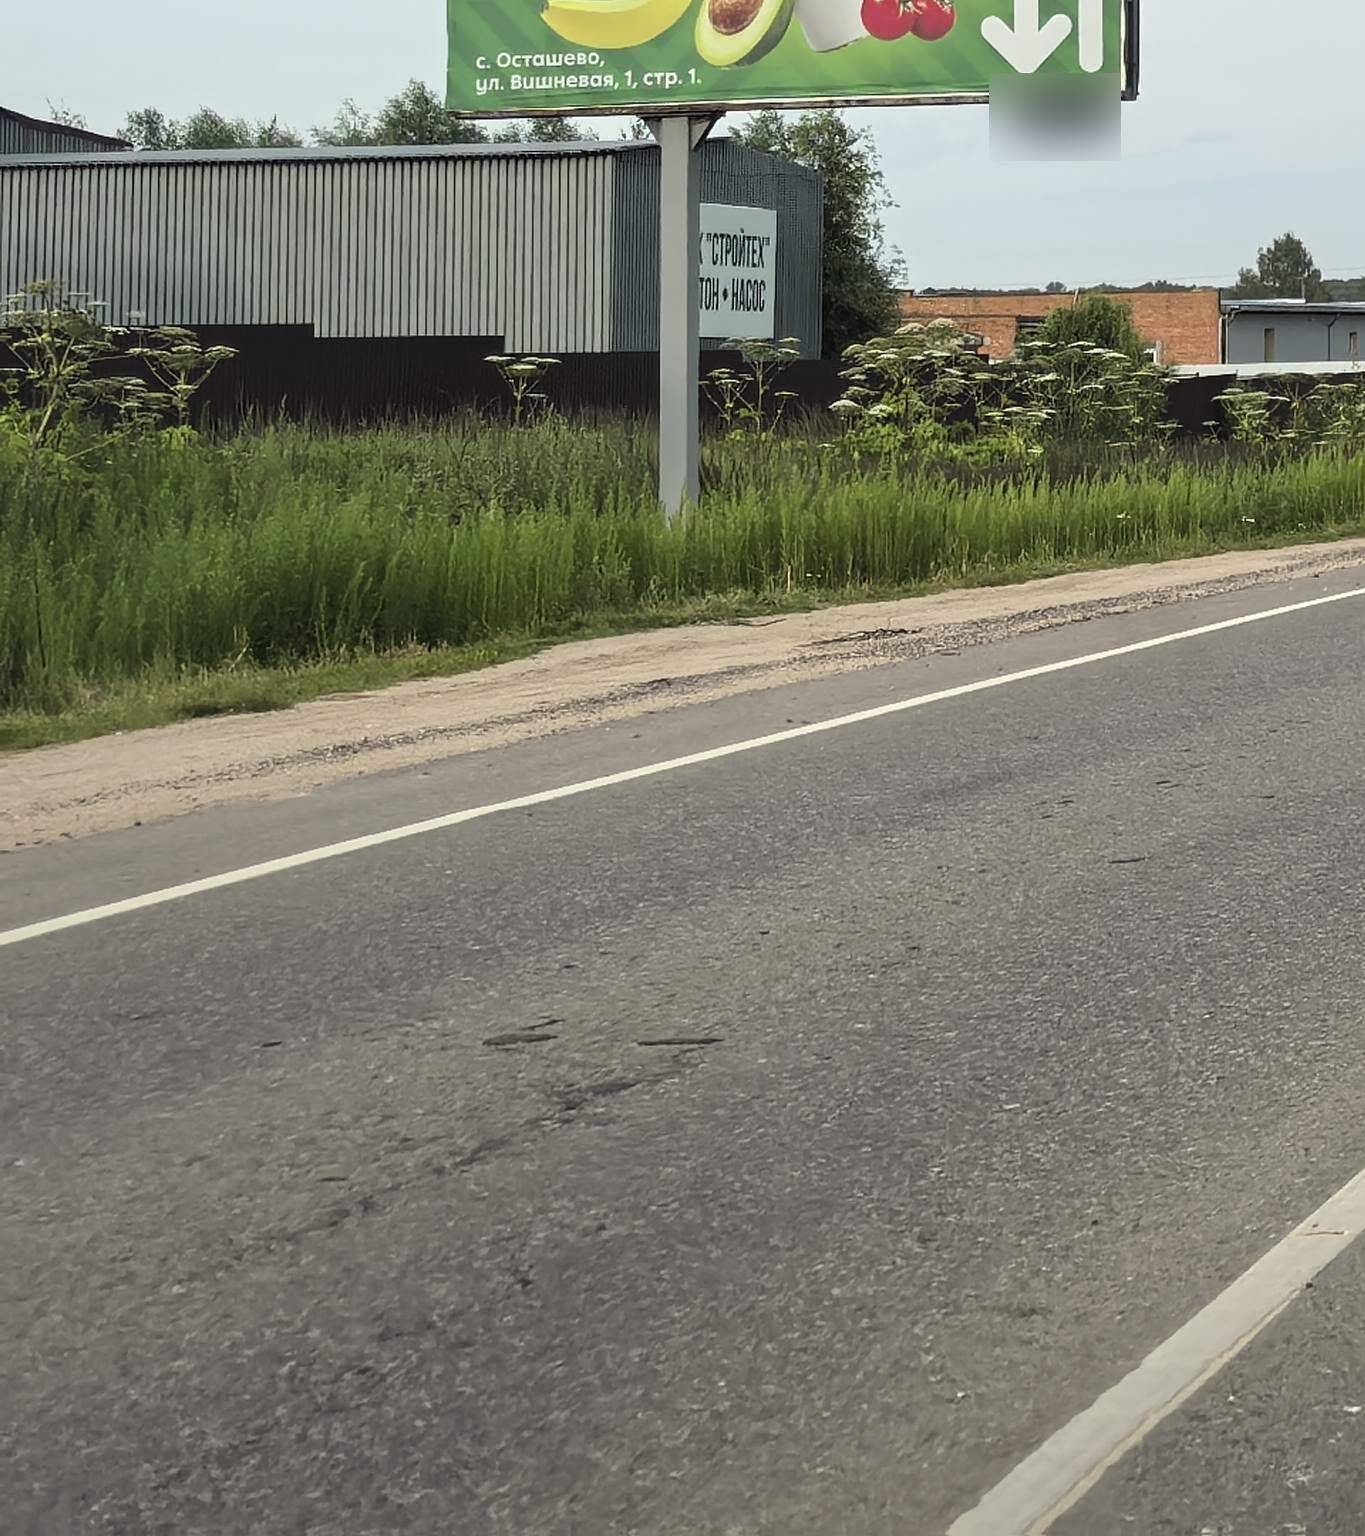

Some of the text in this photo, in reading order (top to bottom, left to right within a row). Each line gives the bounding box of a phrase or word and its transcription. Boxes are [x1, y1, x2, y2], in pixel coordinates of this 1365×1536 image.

[476, 52, 605, 69] с. Осташево,
[476, 68, 702, 95] ул. Вишневая, 1, стр. 1.
[706, 227, 770, 268] "СТРОЙТЕХ"
[699, 277, 766, 312] ТОН НАСОС
